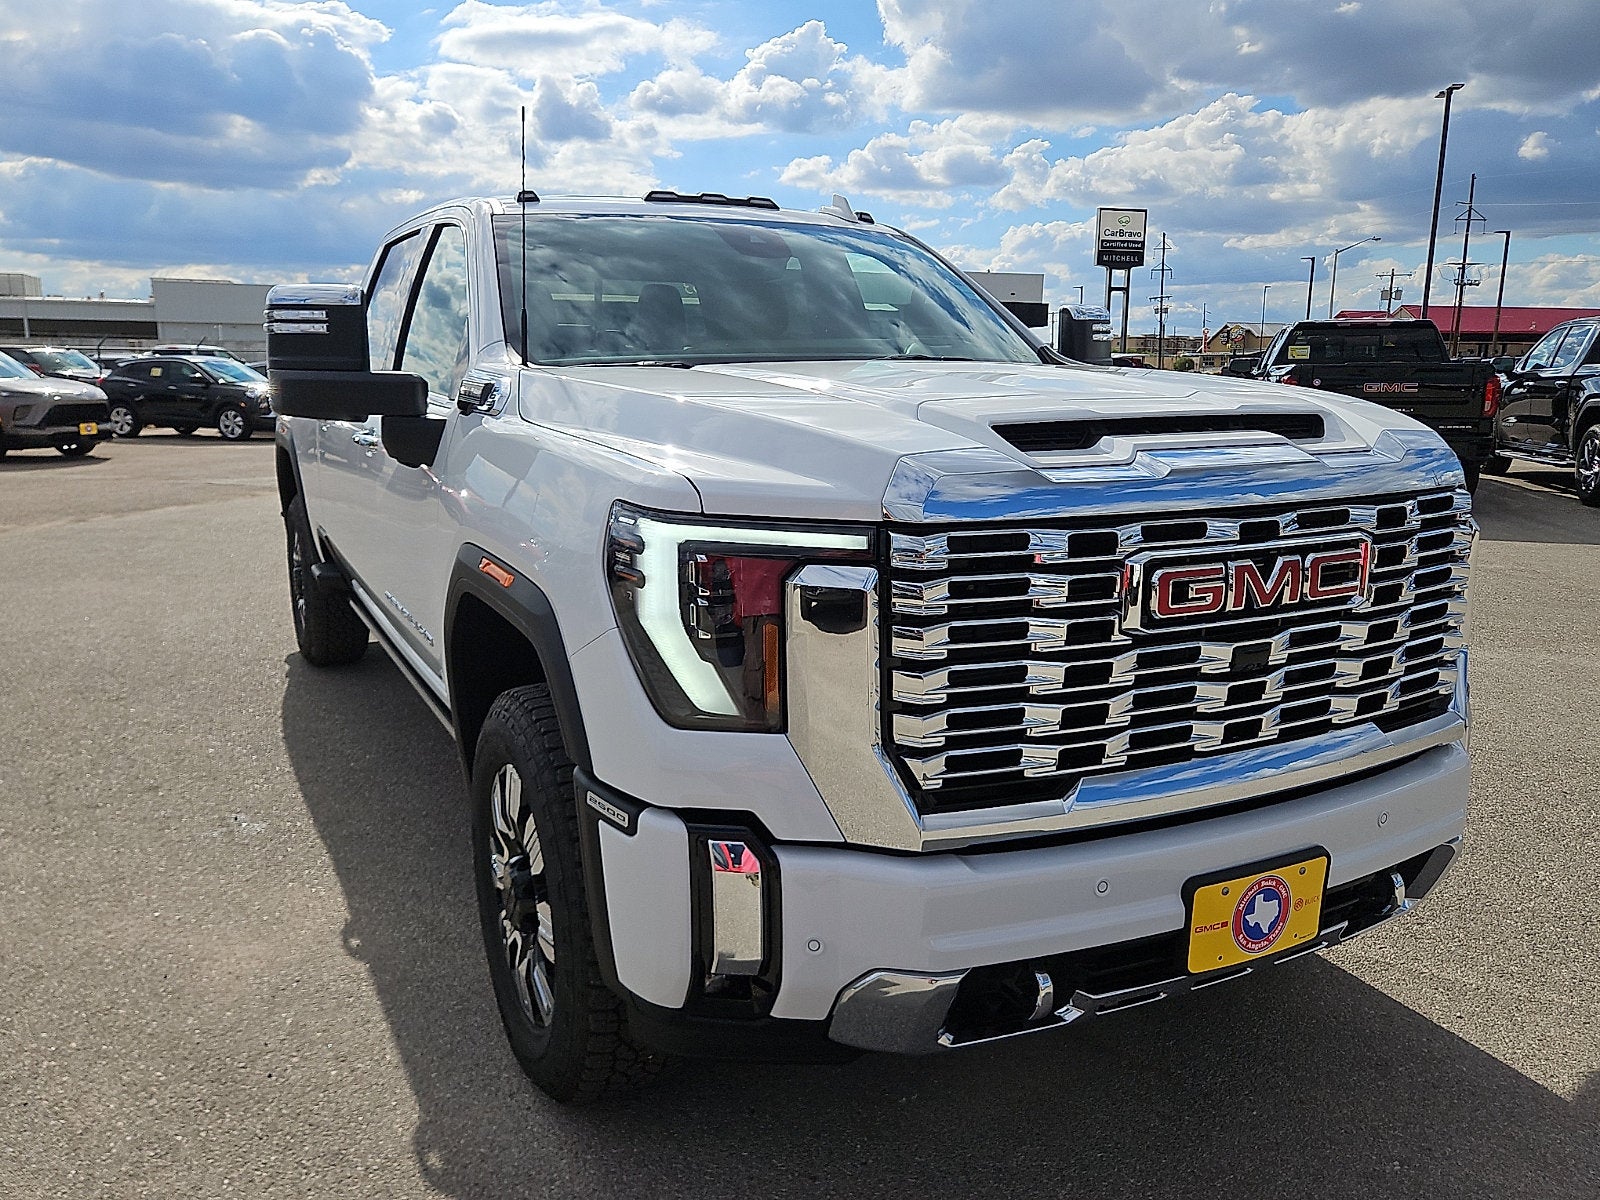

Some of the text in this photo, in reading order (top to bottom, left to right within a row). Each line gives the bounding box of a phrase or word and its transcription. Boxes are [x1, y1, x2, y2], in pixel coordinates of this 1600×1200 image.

[1103, 228, 1142, 238] CarBravo
[1102, 254, 1139, 262] MITCHELL
[1363, 382, 1419, 393] GMC
[1150, 549, 1364, 618] GMC
[588, 795, 626, 822] 2500
[1238, 883, 1260, 911] Mitchell
[1194, 921, 1221, 934] GMC
[1237, 933, 1247, 947] San
